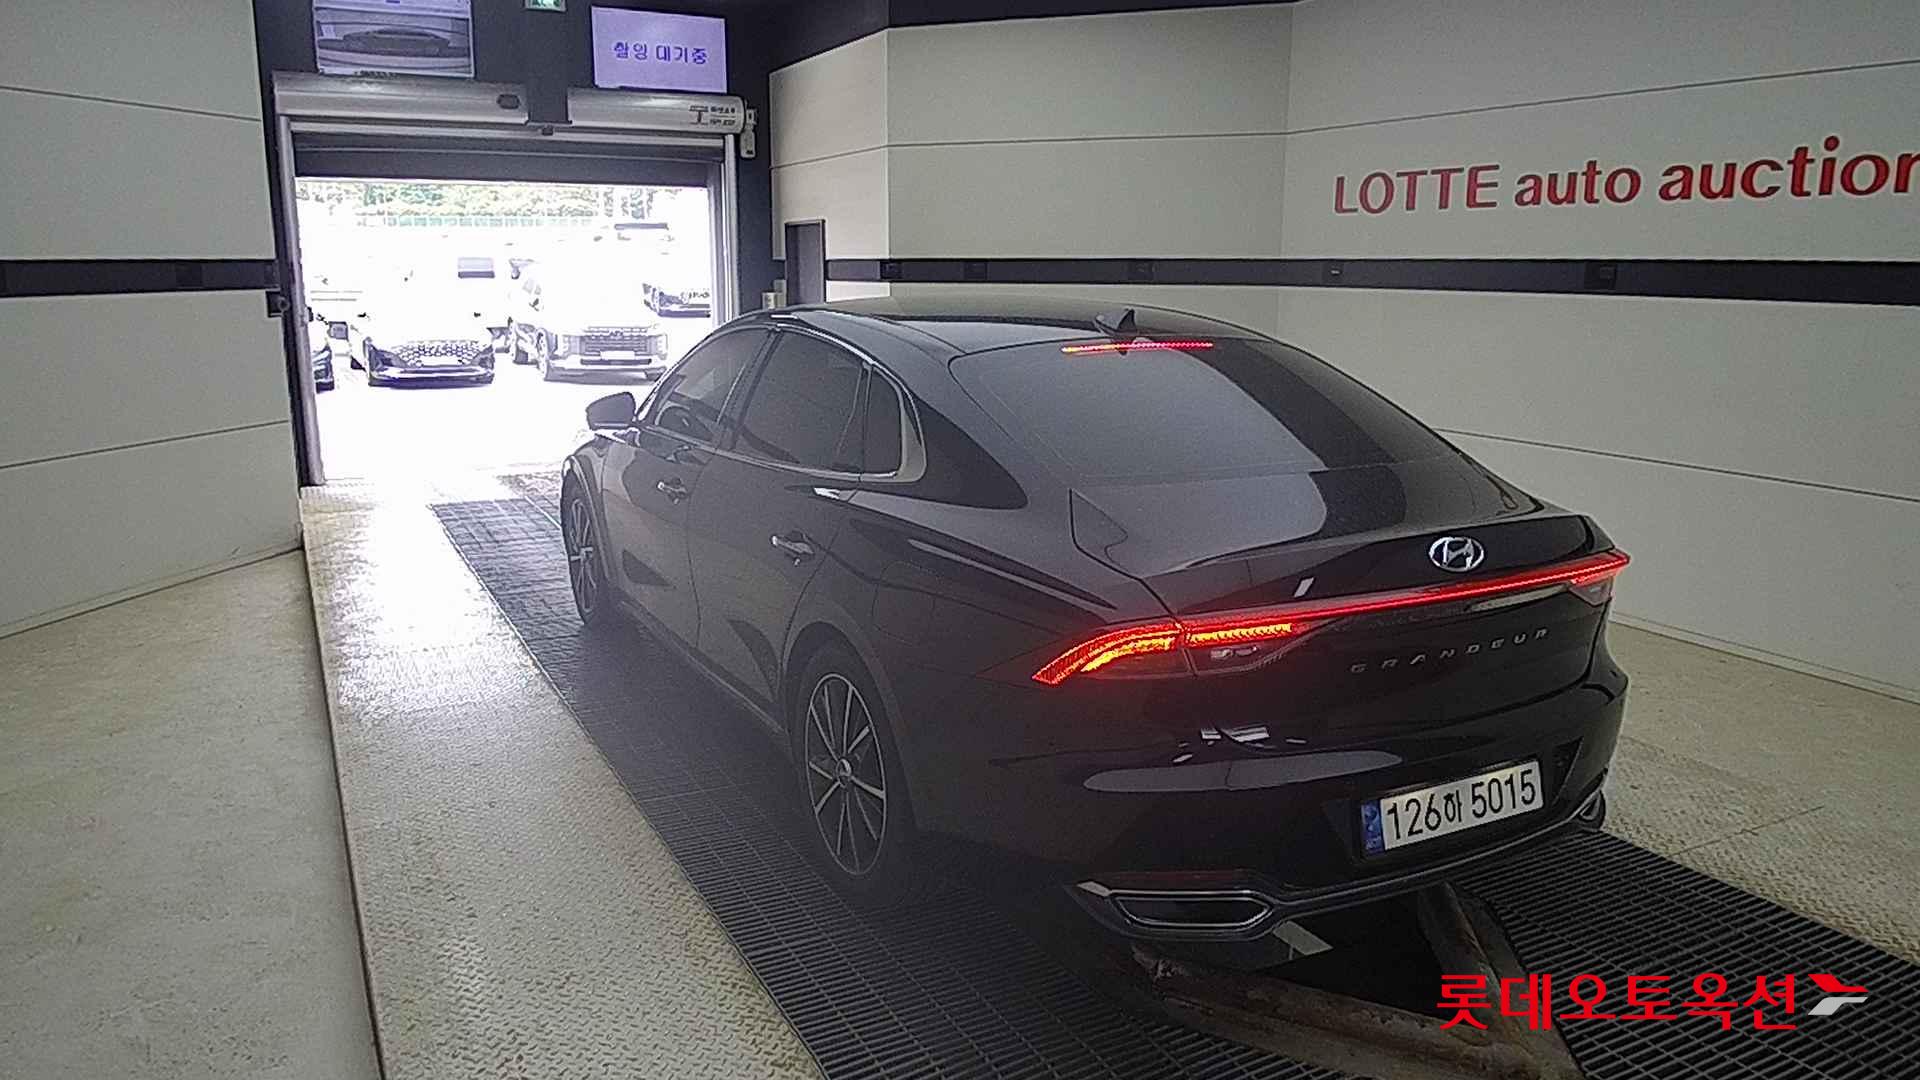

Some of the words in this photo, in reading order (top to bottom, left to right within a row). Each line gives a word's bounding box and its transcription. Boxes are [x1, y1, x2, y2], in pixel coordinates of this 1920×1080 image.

[656, 45, 707, 64] 대기중
[1334, 164, 1500, 213] LOTTE
[1515, 160, 1640, 206] auto
[1351, 628, 1548, 673] GRANDEUR
[1472, 770, 1536, 818] 5015
